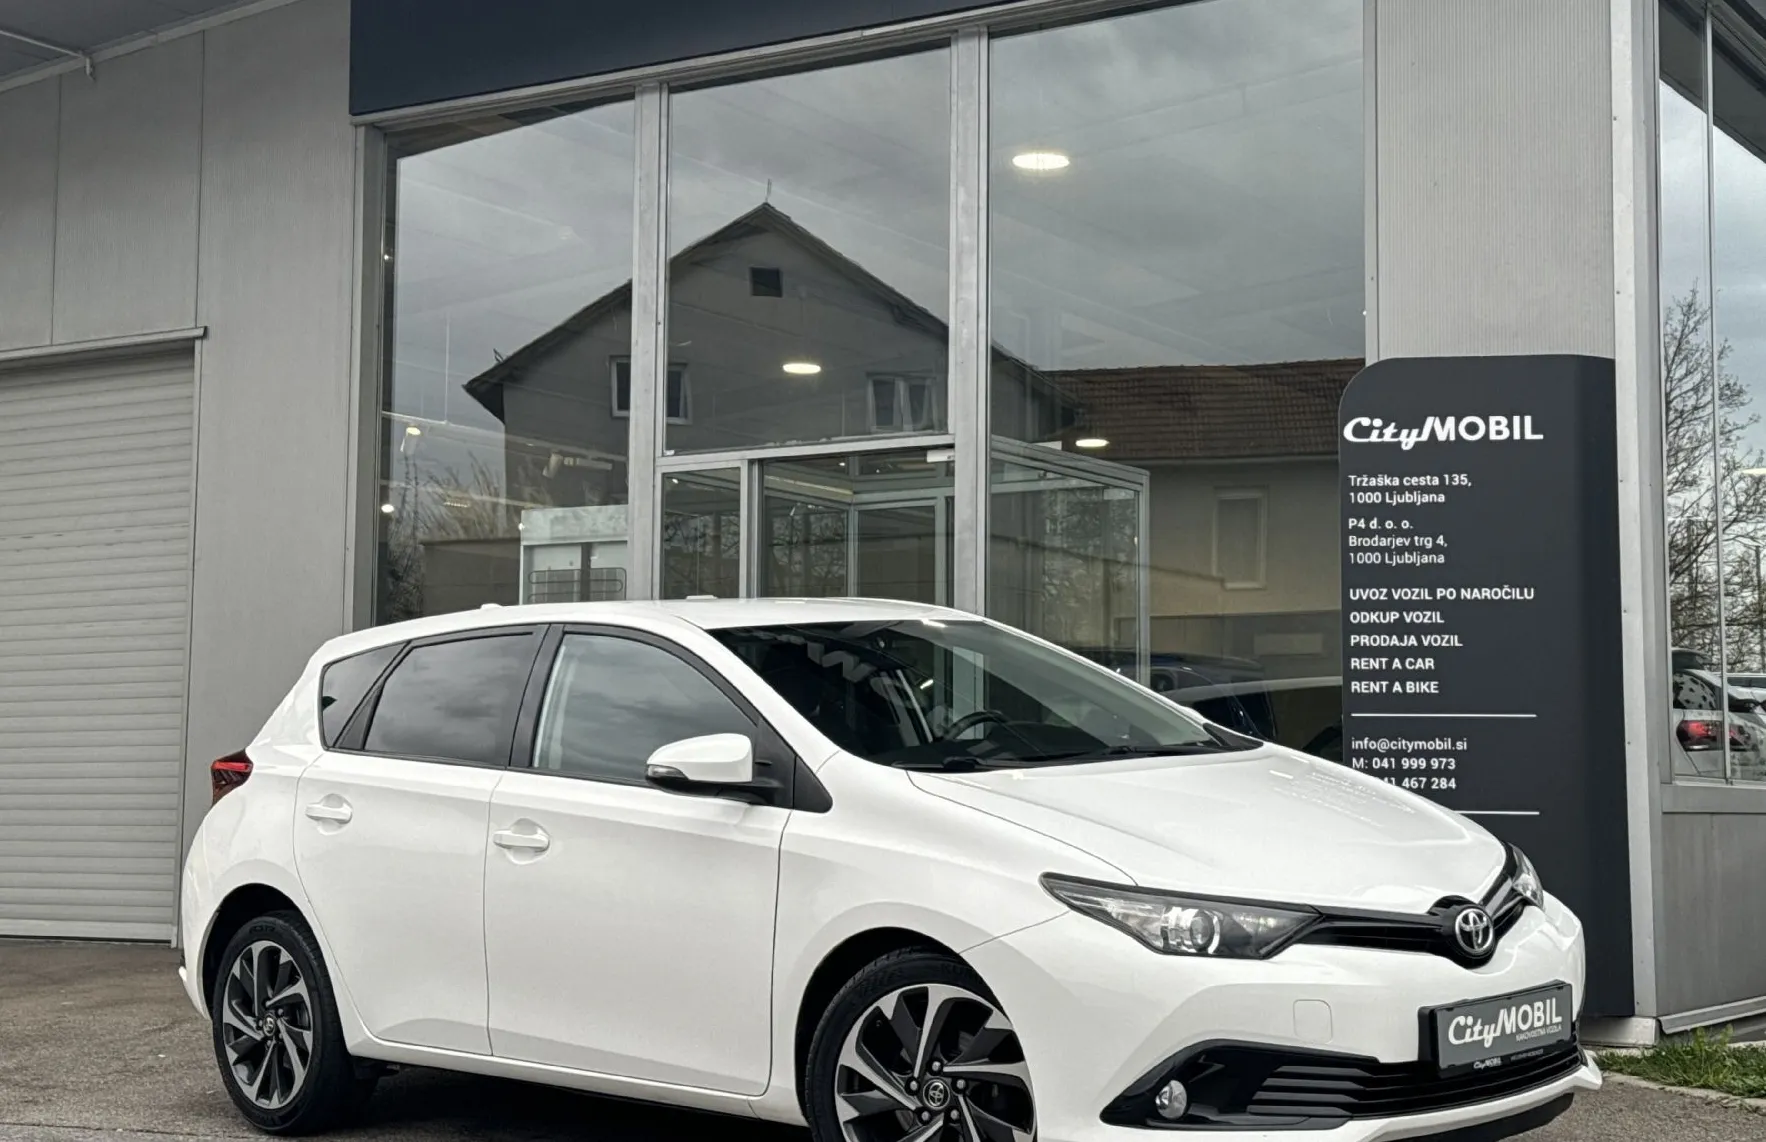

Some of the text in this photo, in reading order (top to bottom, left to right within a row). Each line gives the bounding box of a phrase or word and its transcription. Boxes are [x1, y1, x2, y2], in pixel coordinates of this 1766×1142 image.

[1342, 414, 1544, 451] CityMOBIL
[1347, 473, 1472, 487] Tržaška cesta 135,
[1349, 490, 1446, 507] 1000 Ljubljana
[1348, 517, 1366, 530] P4
[1348, 534, 1448, 550] Brodarjev trg 4,
[1349, 551, 1445, 567] 1000 Ljubljana
[1349, 584, 1535, 601] UVOZ VOZIL PO NAROČILU
[1349, 610, 1445, 624] ODKUP VOZIL
[1350, 634, 1464, 647] PRODAJA VOZIL
[1350, 657, 1435, 670] RENT A CAR
[1350, 680, 1440, 694] RENT A BIKE
[1351, 736, 1468, 753] info@citymobil.si
[1352, 757, 1456, 770] M: 041 999 973
[1401, 776, 1428, 789] 467
[1430, 777, 1457, 790] 284
[1448, 997, 1563, 1049] CityMOBIL
